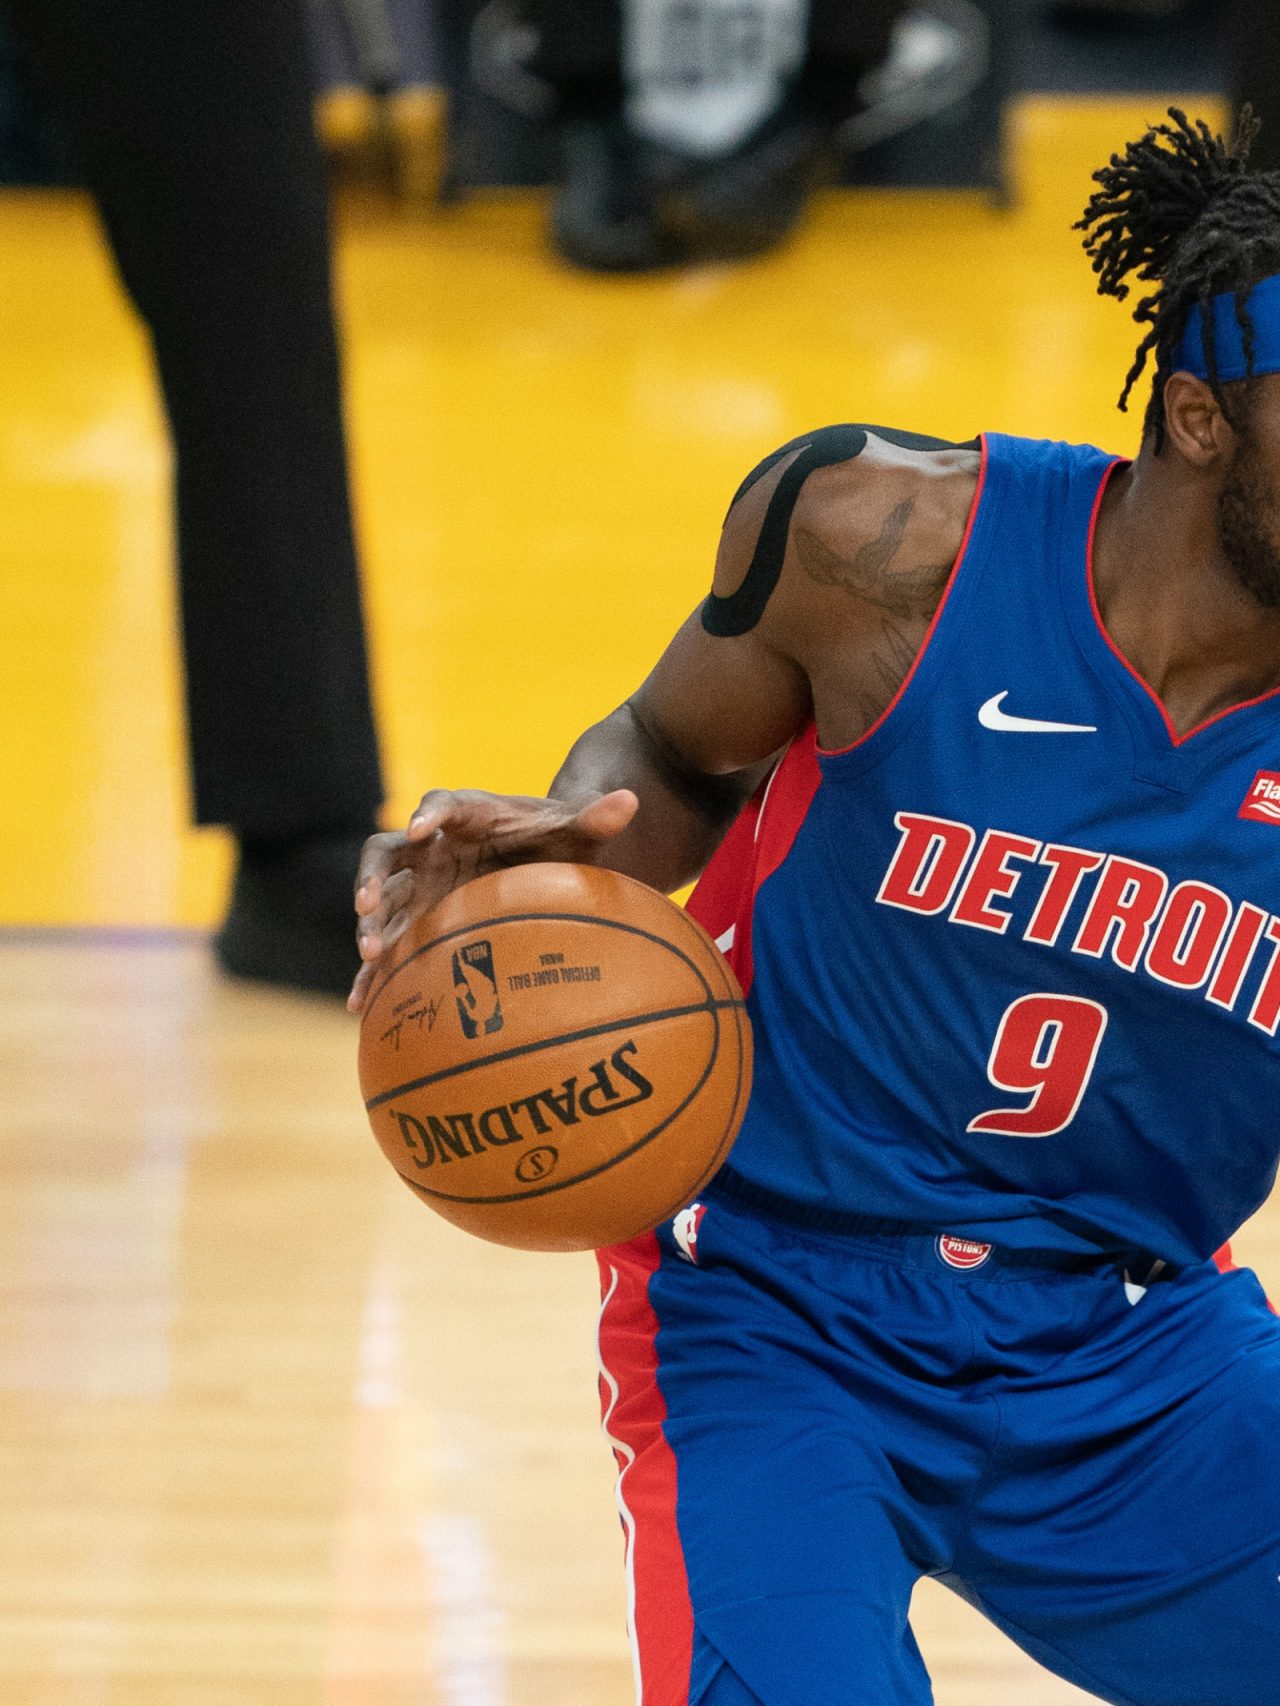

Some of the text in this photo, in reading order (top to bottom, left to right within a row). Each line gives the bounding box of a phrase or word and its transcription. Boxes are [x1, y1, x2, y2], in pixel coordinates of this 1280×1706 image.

[507, 973, 532, 992] BALL
[531, 968, 560, 988] GAME
[966, 992, 1108, 1138] 9
[396, 1039, 654, 1169] SPALDING
[947, 1240, 983, 1254] PISTONS
